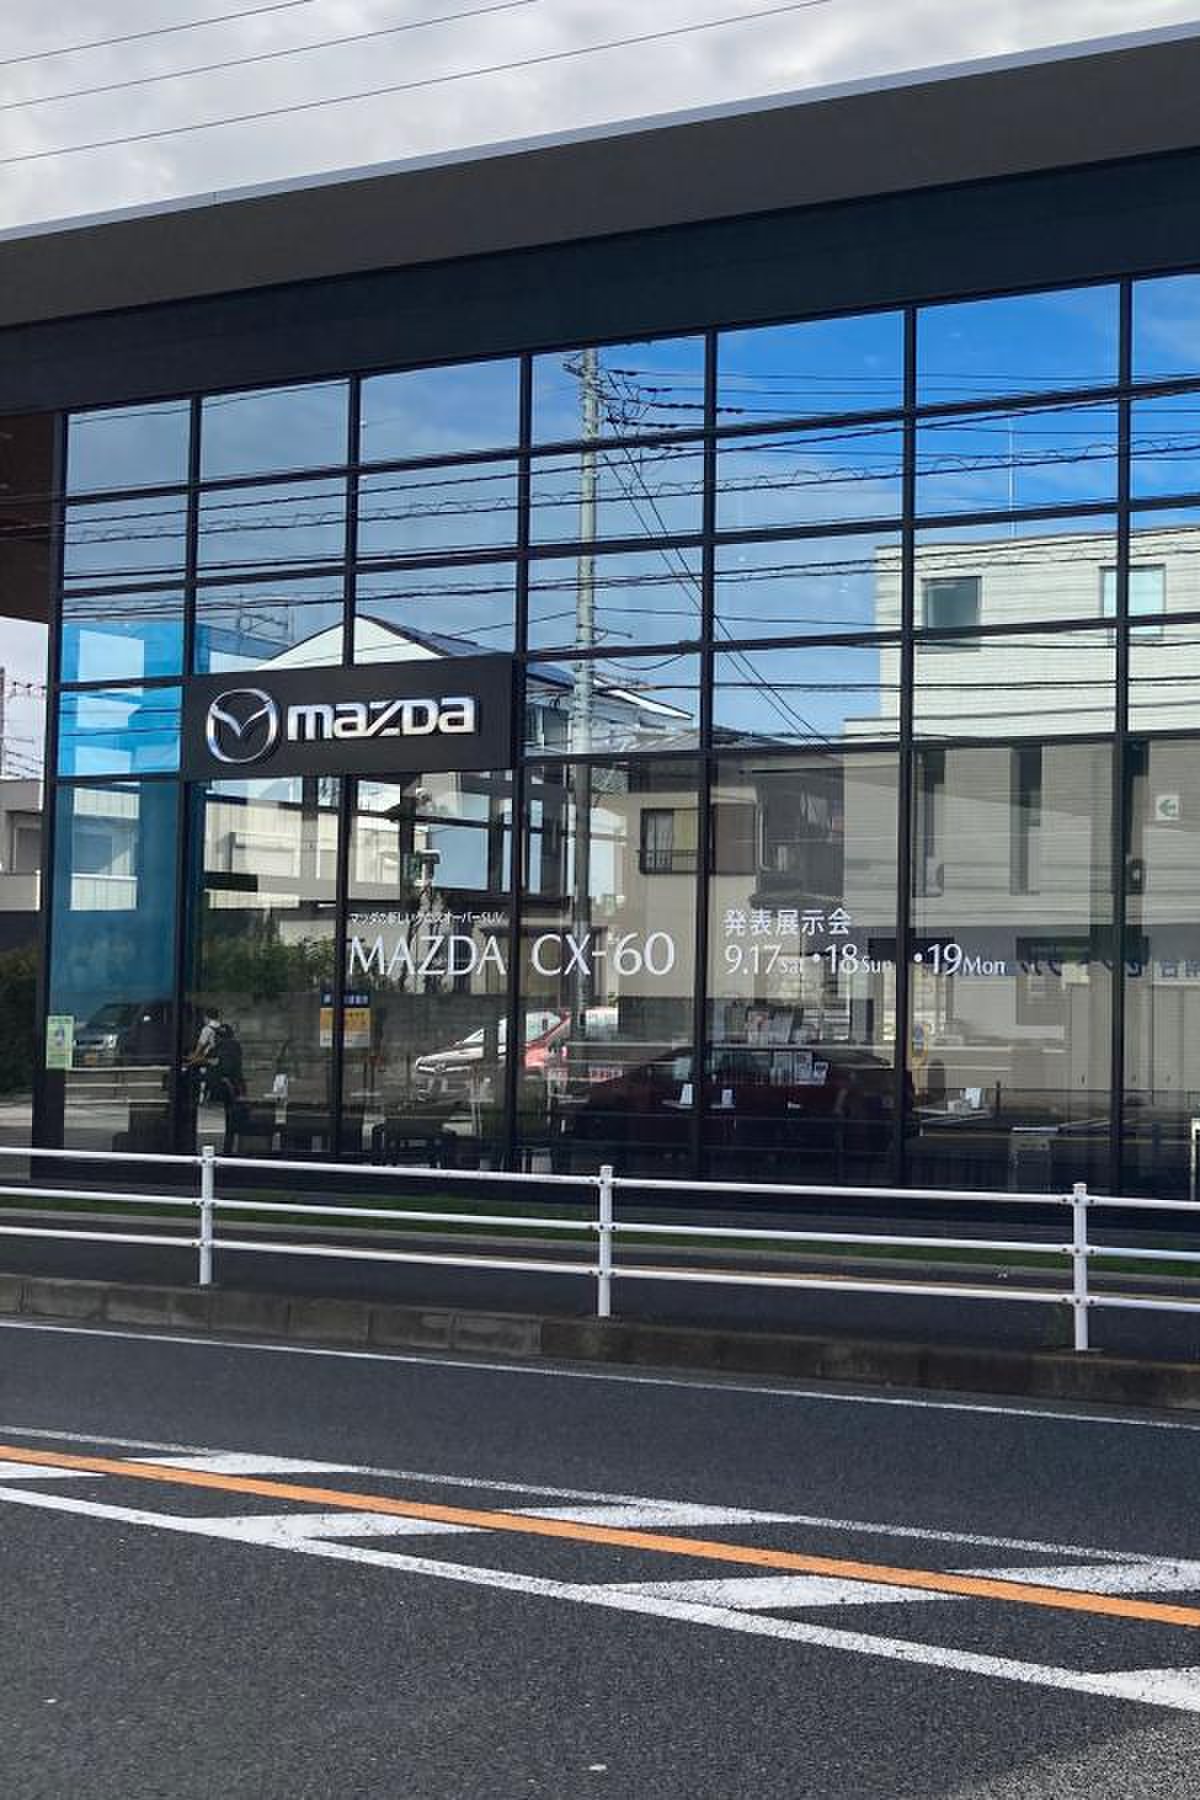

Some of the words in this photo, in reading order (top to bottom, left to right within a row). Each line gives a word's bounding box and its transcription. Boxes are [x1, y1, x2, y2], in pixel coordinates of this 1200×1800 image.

[724, 907, 852, 937] 発表展示会
[349, 934, 508, 976] MAZDA
[531, 932, 676, 976] CX-60
